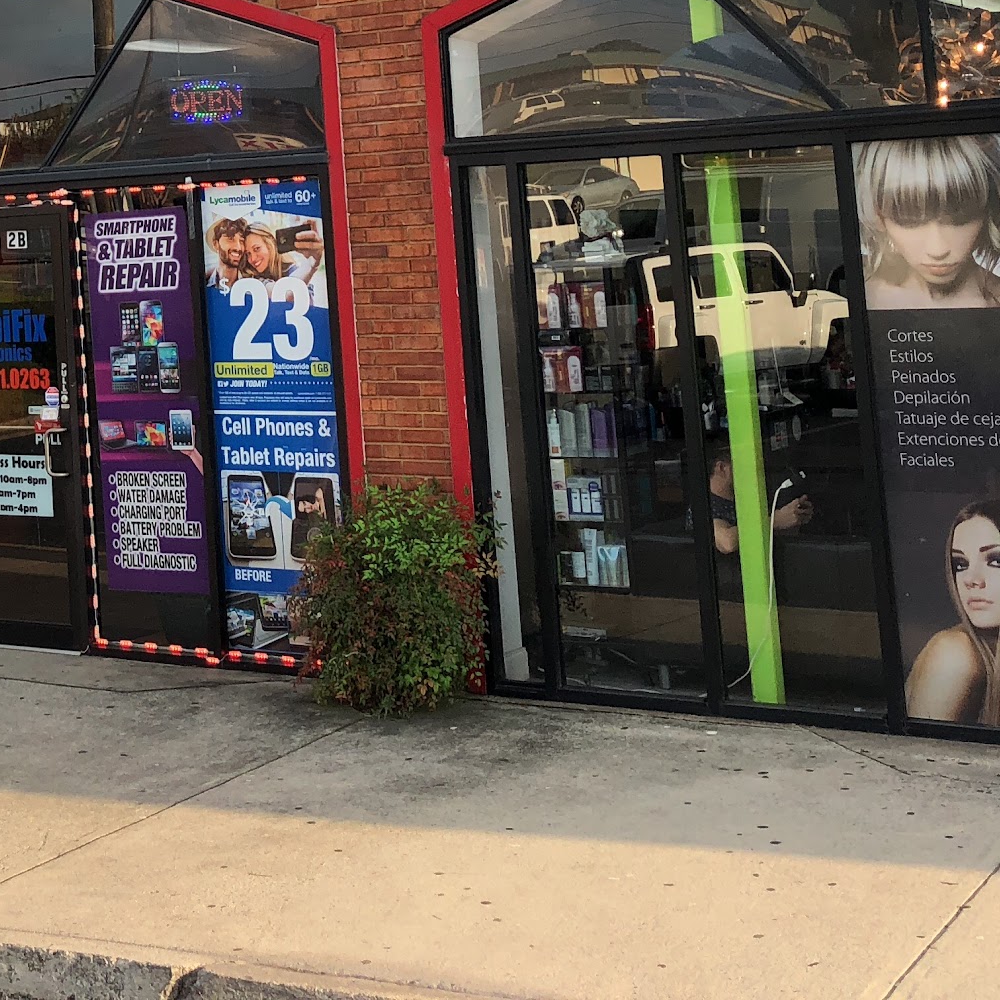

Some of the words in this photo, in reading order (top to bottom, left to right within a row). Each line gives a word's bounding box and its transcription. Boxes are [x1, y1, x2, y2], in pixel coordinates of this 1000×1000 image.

[170, 89, 243, 113] OPEN
[209, 194, 256, 206] Lycamobile
[295, 190, 316, 203] 60+
[96, 217, 174, 236] SMARTPHONE
[8, 231, 26, 248] 2B
[98, 243, 111, 260] &
[114, 236, 175, 259] TABLET
[100, 262, 178, 291] REPAIR
[219, 277, 314, 361] $23
[888, 329, 933, 342] Cortes
[889, 349, 933, 363] Estilos
[216, 364, 267, 376] Unlimited
[891, 370, 956, 384] Peinados
[893, 390, 971, 407] Depilación
[895, 411, 947, 428] Tatuaje
[950, 411, 969, 425] de
[222, 417, 250, 436] Cell
[255, 417, 313, 438] Phones
[318, 419, 331, 437] &
[898, 432, 985, 447] Extenciones
[988, 432, 1000, 447] d
[12, 456, 45, 470] Hours
[221, 446, 270, 467] Tablet
[274, 448, 335, 470] Repairs
[900, 452, 955, 467] Faciales
[0, 474, 47, 487] 10am-8pm
[116, 473, 150, 488] BROKEN
[152, 473, 185, 488] SCREEN
[118, 489, 147, 503] WATER
[150, 490, 185, 503] DAMAGE
[119, 505, 161, 519] CHARGING
[164, 506, 186, 520] PORT
[120, 521, 158, 536] BATTERY
[160, 523, 201, 537] PROBLEM
[121, 538, 159, 551] SPEAKER
[122, 554, 142, 568] FULL
[144, 555, 196, 571] DIAGNOSTIC
[234, 568, 272, 583] BEFORE
